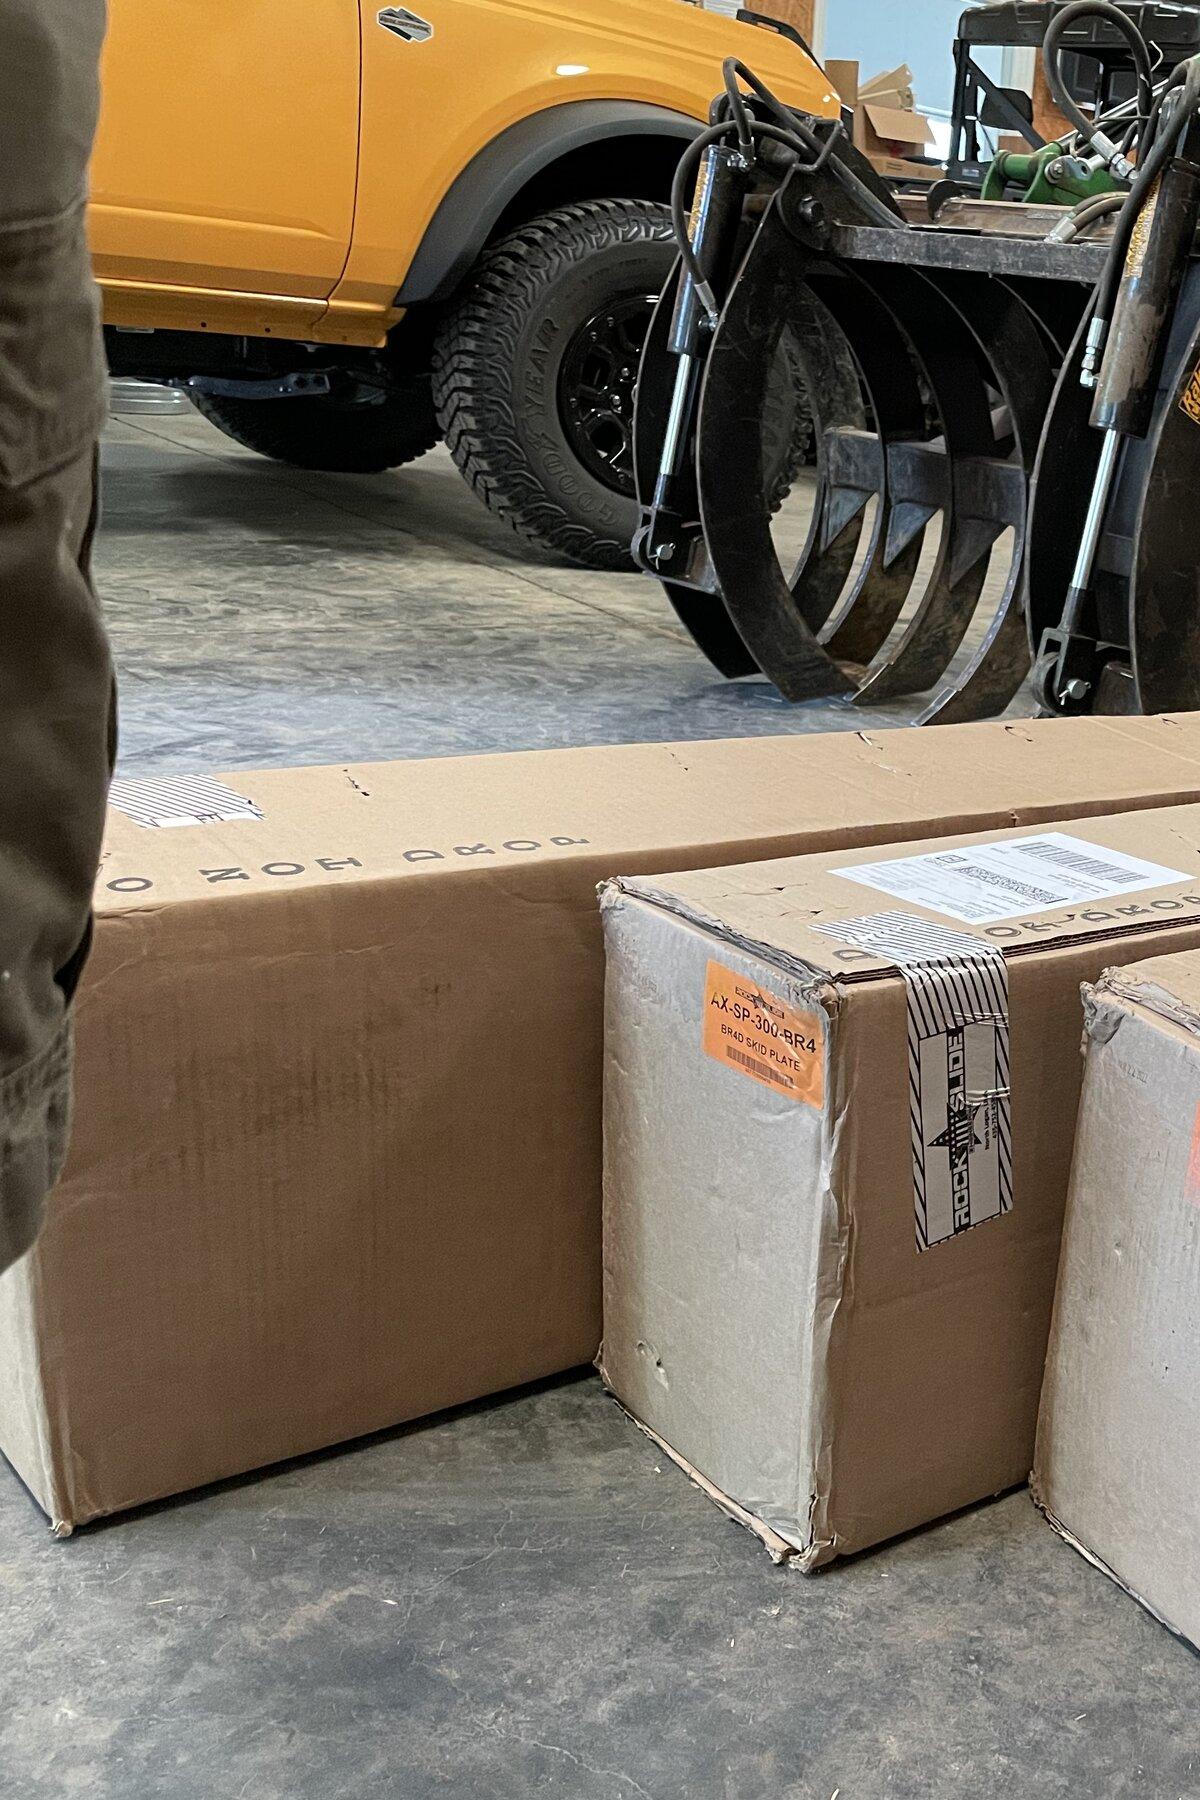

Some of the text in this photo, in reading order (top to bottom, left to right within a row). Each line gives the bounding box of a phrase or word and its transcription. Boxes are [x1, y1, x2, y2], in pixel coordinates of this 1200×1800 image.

[198, 856, 363, 884] NOT
[402, 836, 590, 863] DROP
[832, 949, 878, 963] D
[711, 992, 817, 1054] AX-SP-300-BR4
[746, 1037, 768, 1056] SKID
[769, 1050, 801, 1073] PLATE
[948, 1031, 970, 1229] ROCK SLIDE
